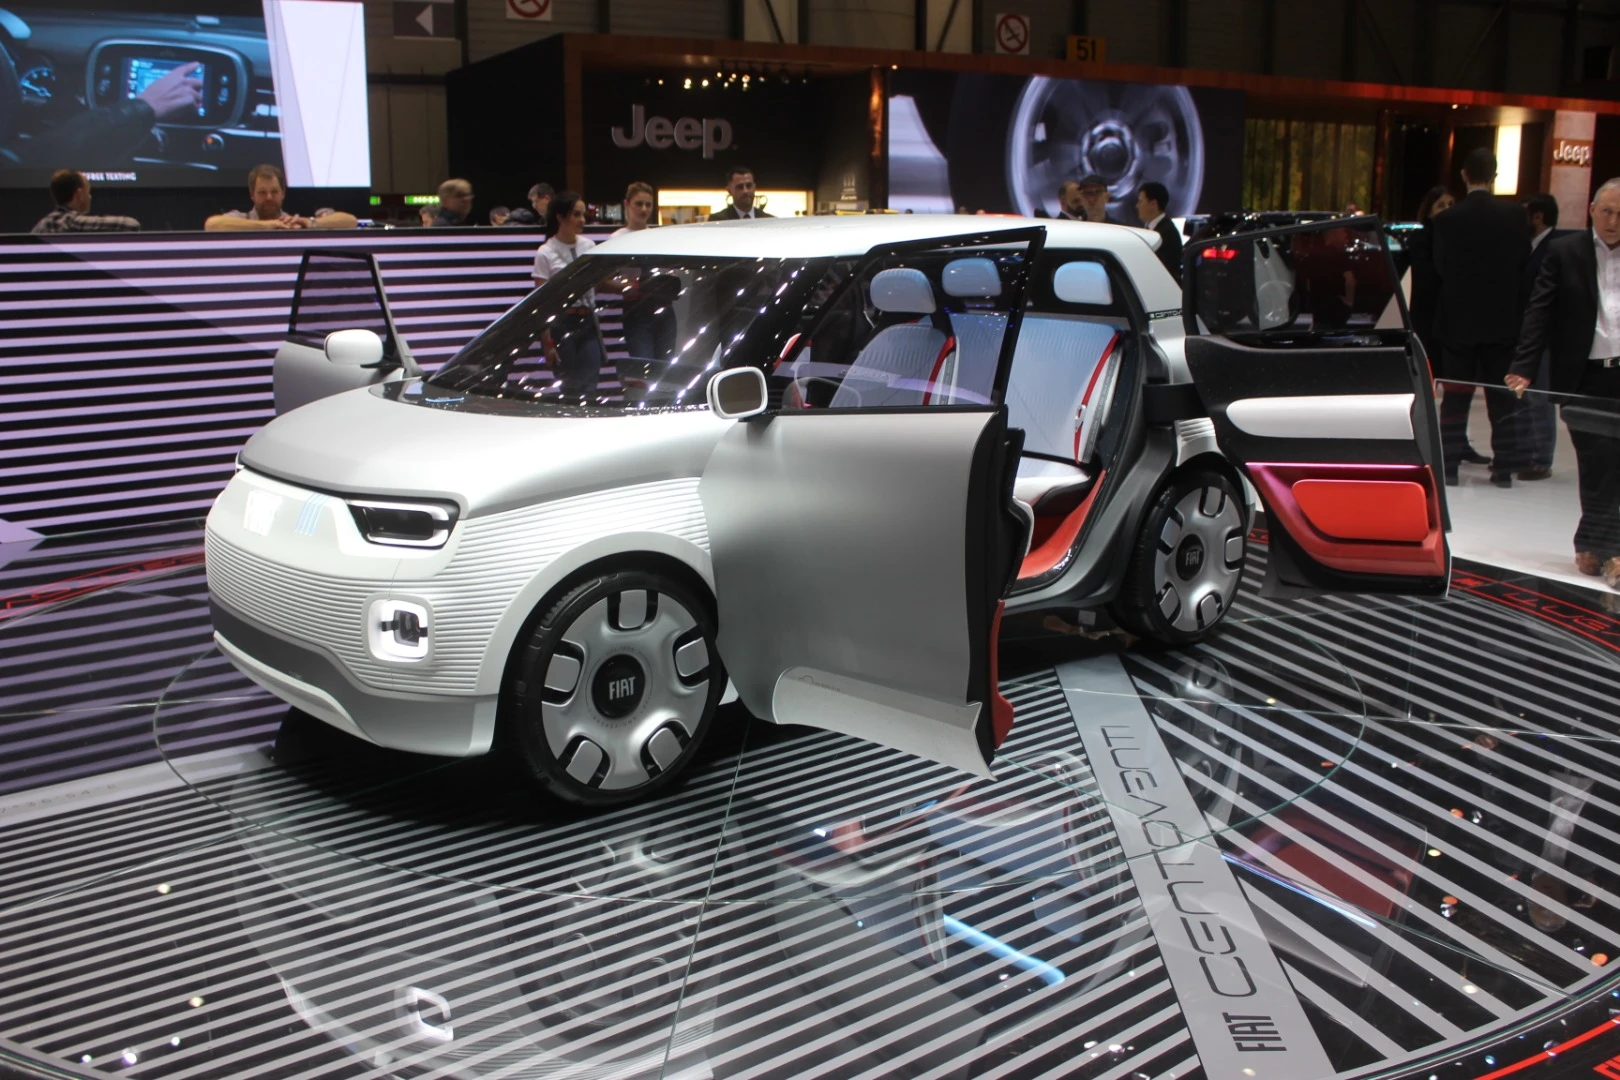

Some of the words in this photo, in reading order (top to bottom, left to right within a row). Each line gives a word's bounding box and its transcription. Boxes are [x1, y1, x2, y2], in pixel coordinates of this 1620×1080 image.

[1077, 38, 1096, 61] 51
[612, 104, 733, 159] Jeep
[1553, 141, 1590, 165] Jeep
[1186, 550, 1203, 566] FIAT
[609, 676, 636, 701] FIAT
[1222, 1012, 1287, 1052] FIAT
